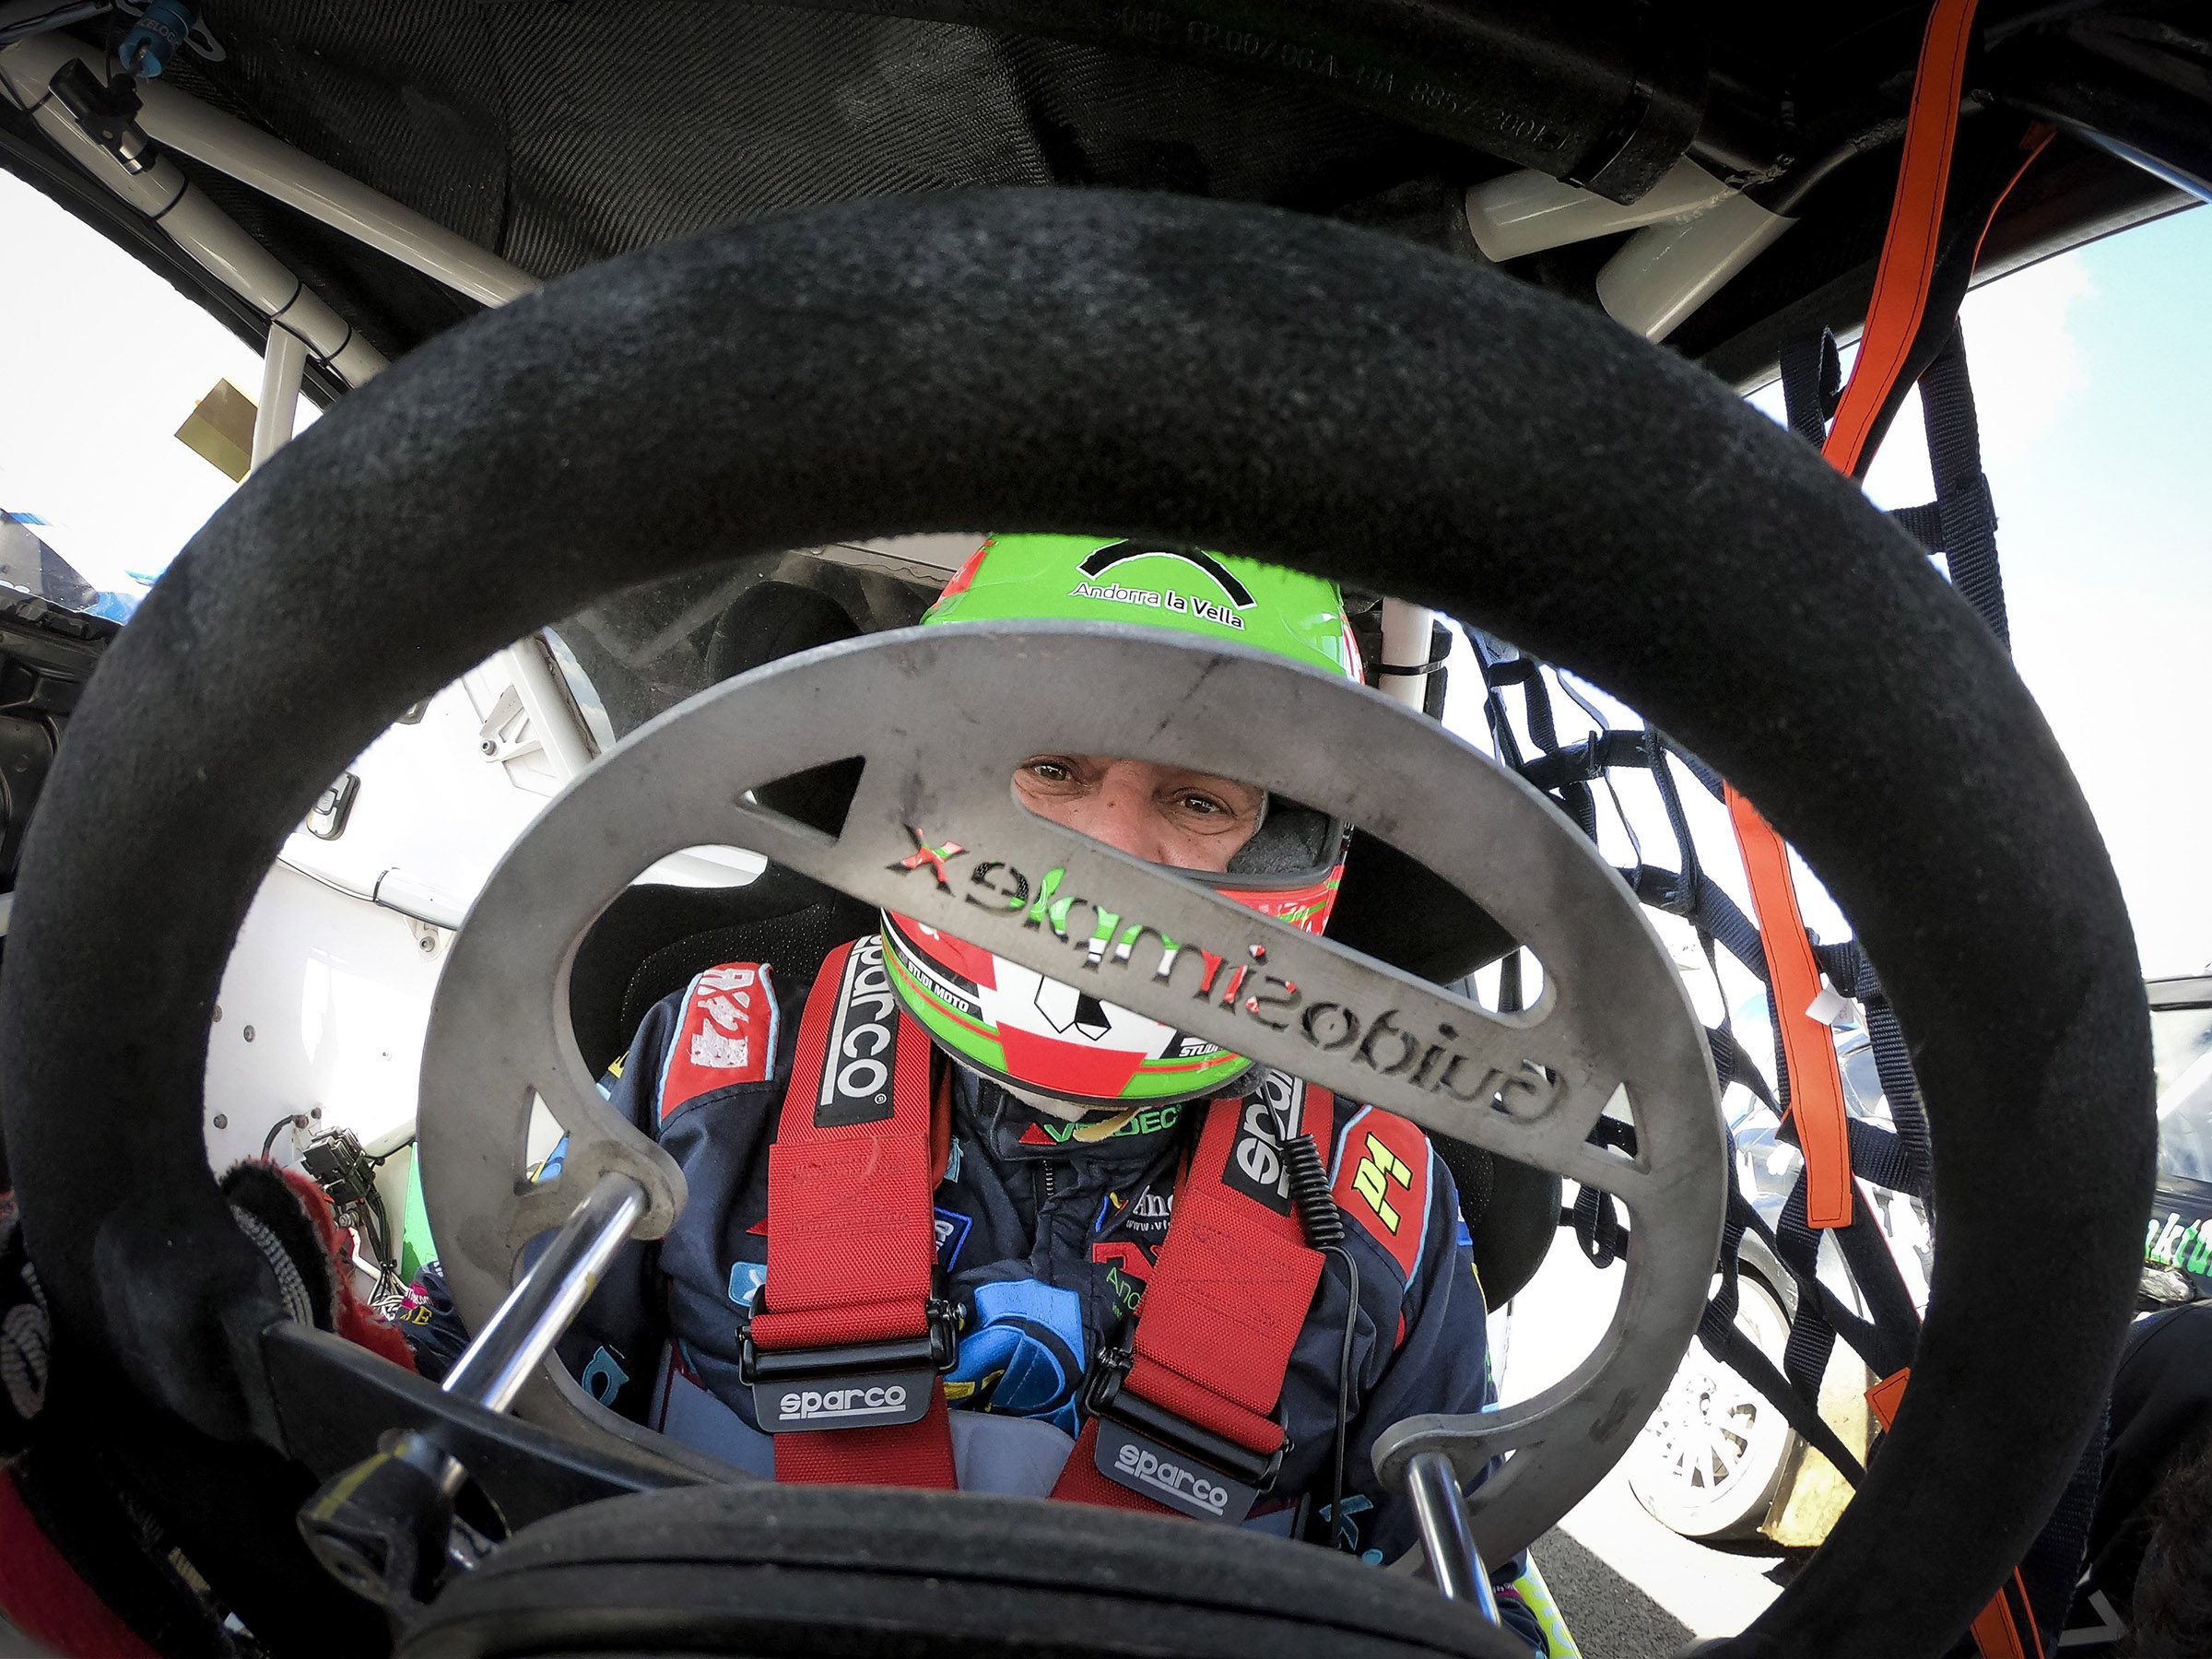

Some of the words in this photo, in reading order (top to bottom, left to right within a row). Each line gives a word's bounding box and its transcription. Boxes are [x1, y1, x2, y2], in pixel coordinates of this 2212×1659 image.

[1074, 582, 1159, 605] Andorra
[1168, 591, 1185, 610] la
[1193, 597, 1242, 629] Vella
[907, 960, 935, 992] STUDI
[934, 983, 970, 1013] MOTO
[780, 1385, 907, 1419] sparco
[1119, 1444, 1228, 1507] sparco
